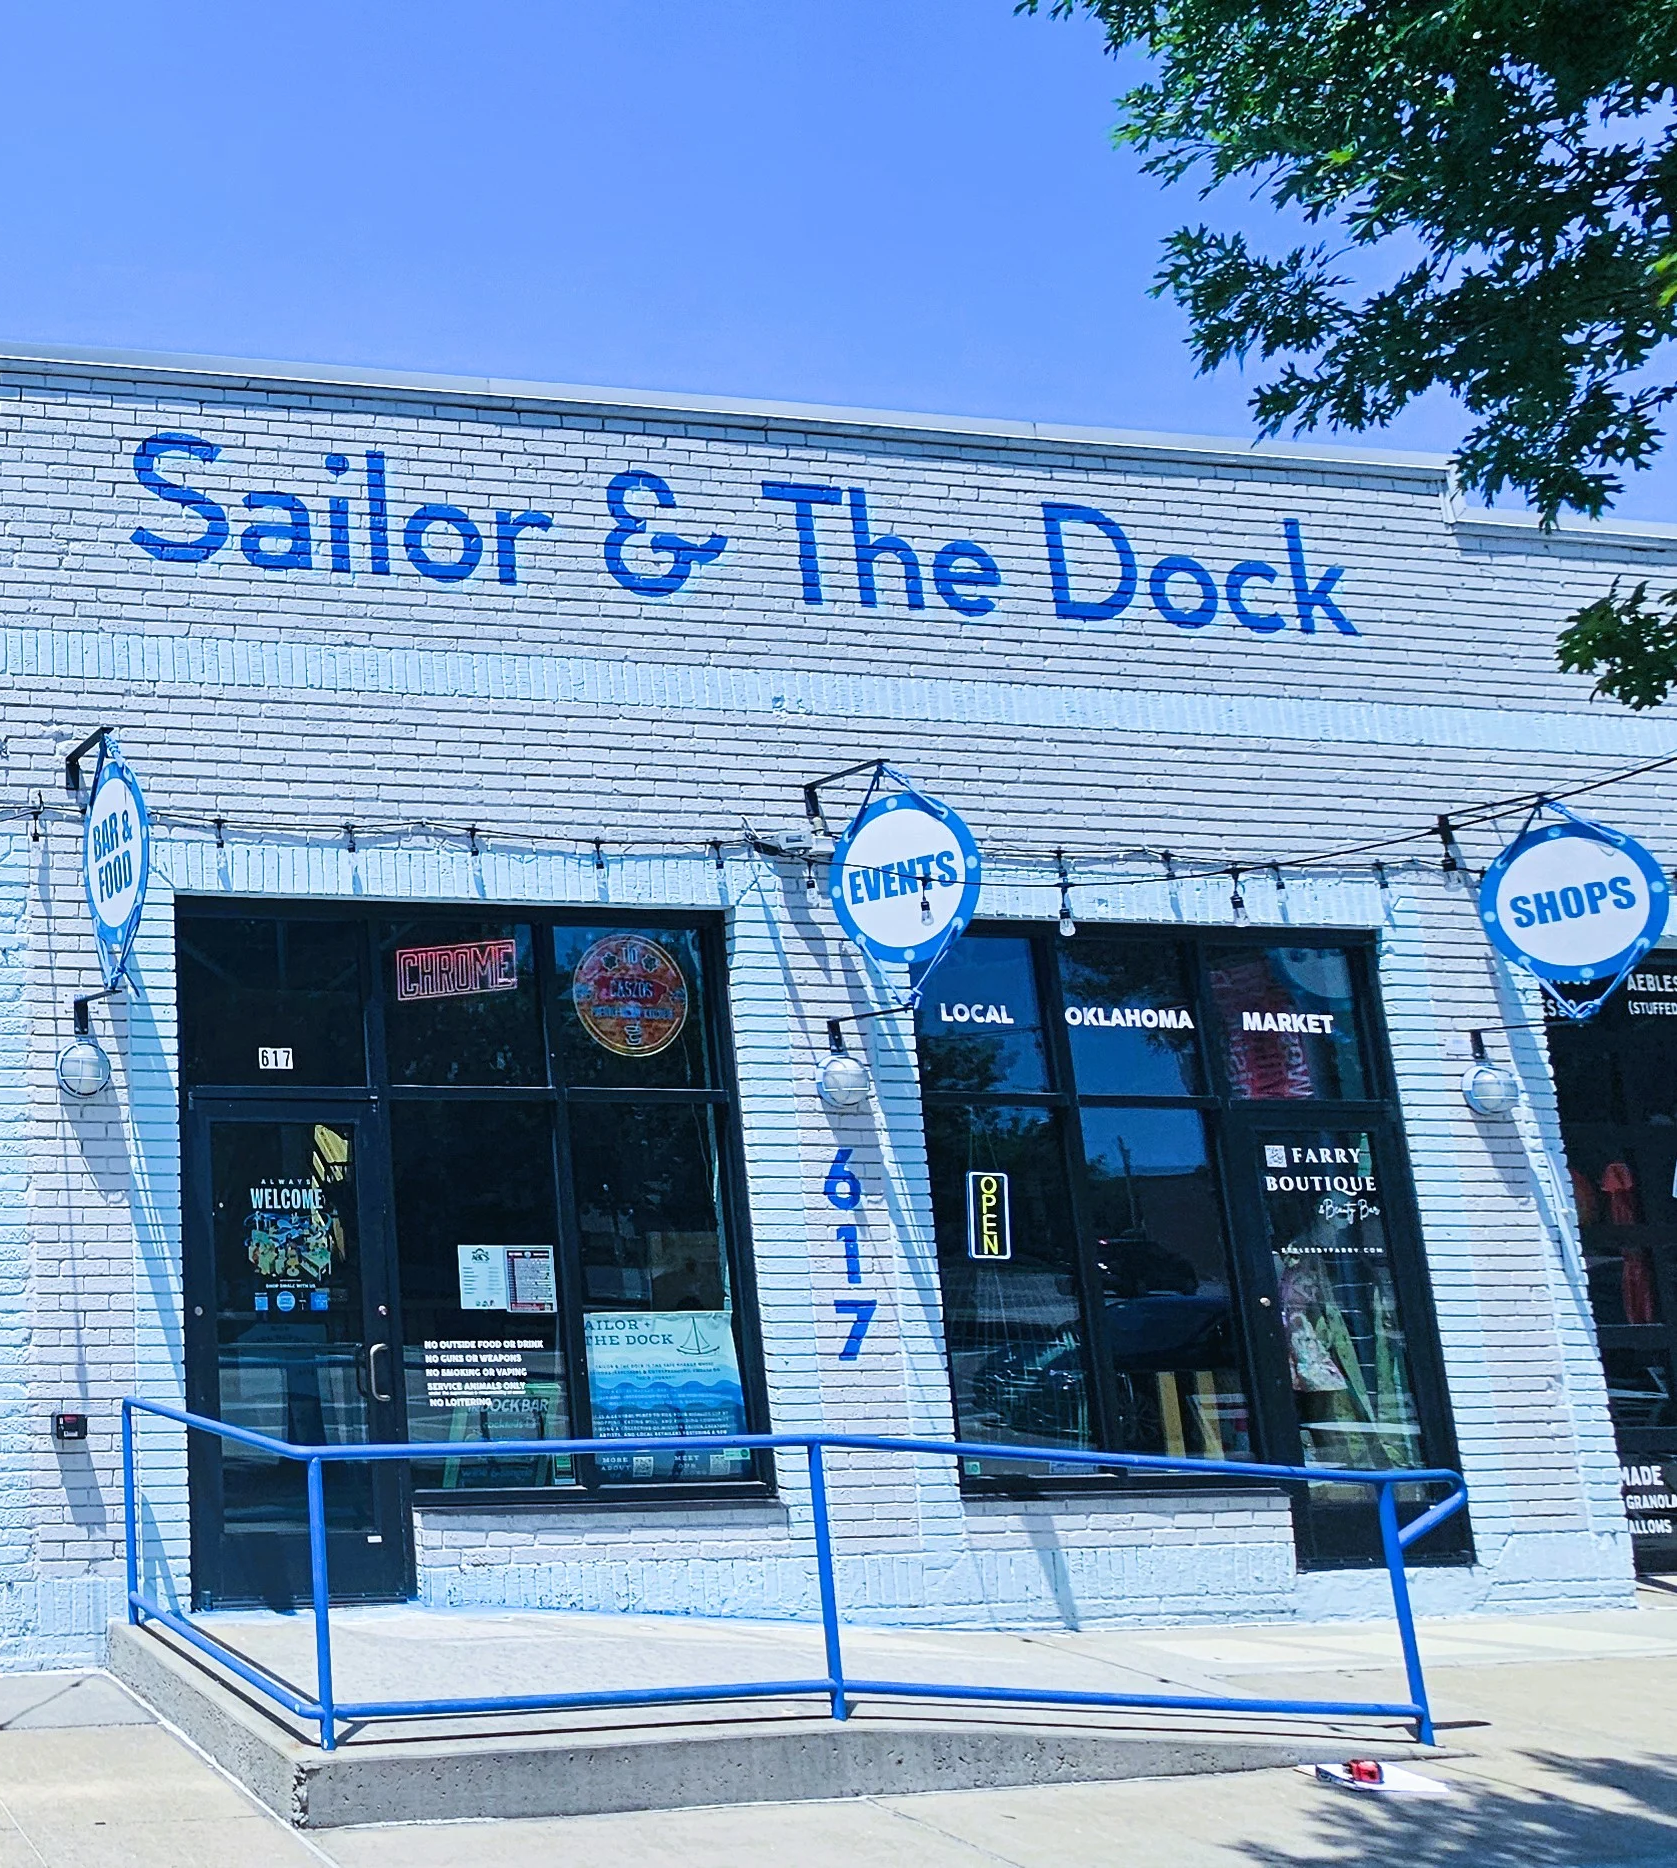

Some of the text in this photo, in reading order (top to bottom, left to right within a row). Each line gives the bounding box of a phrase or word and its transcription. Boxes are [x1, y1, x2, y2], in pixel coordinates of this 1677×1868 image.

[129, 431, 1361, 638] Sailor & The Dock
[93, 809, 133, 863] BAR &
[98, 850, 133, 903] FOOD
[849, 851, 958, 905] EVENTS
[1510, 876, 1637, 928] SHOPS
[401, 945, 514, 997] CHROME
[940, 1003, 1334, 1034] LOCAL OKLAHOMA MARKET
[260, 1048, 292, 1067] 617
[1291, 1147, 1361, 1164] FARRY
[1265, 1176, 1377, 1196] BOUTIQUE
[250, 1187, 324, 1210] WELCOME
[980, 1176, 999, 1255] OPEN
[823, 1149, 878, 1361] 617
[424, 1340, 545, 1350] NO OUTSIDE FOOD OR DRINK
[585, 1334, 674, 1346] THE DOCK
[425, 1353, 523, 1363] NO GUNS OR WEAPONS
[425, 1367, 528, 1377] NO SMOKING OR VAPING
[427, 1382, 526, 1391] SERVICE ANIMALS ONLY
[429, 1397, 493, 1407] NO LOITERING
[522, 1397, 549, 1413] BAR
